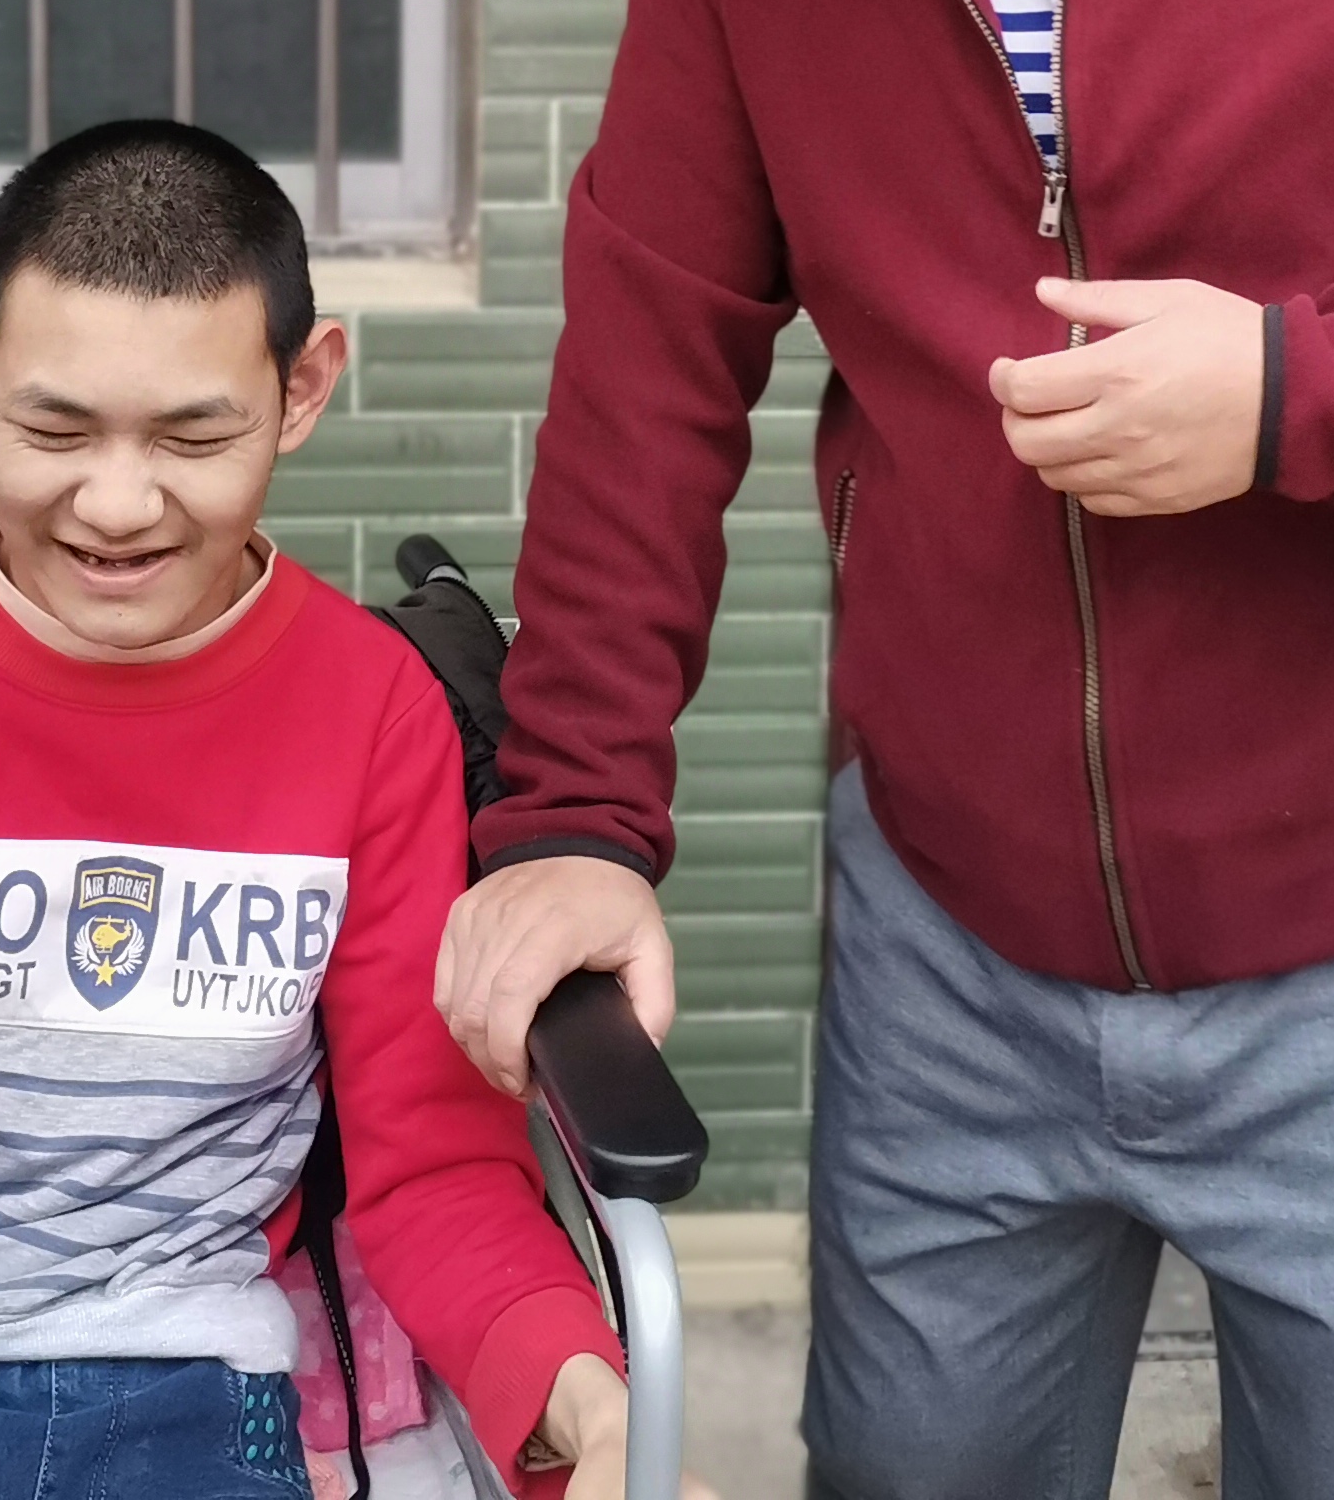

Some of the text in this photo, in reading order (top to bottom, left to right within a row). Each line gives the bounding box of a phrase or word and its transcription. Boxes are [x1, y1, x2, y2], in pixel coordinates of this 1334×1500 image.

[85, 874, 150, 902] AIR BORNE
[176, 880, 348, 970] KRB
